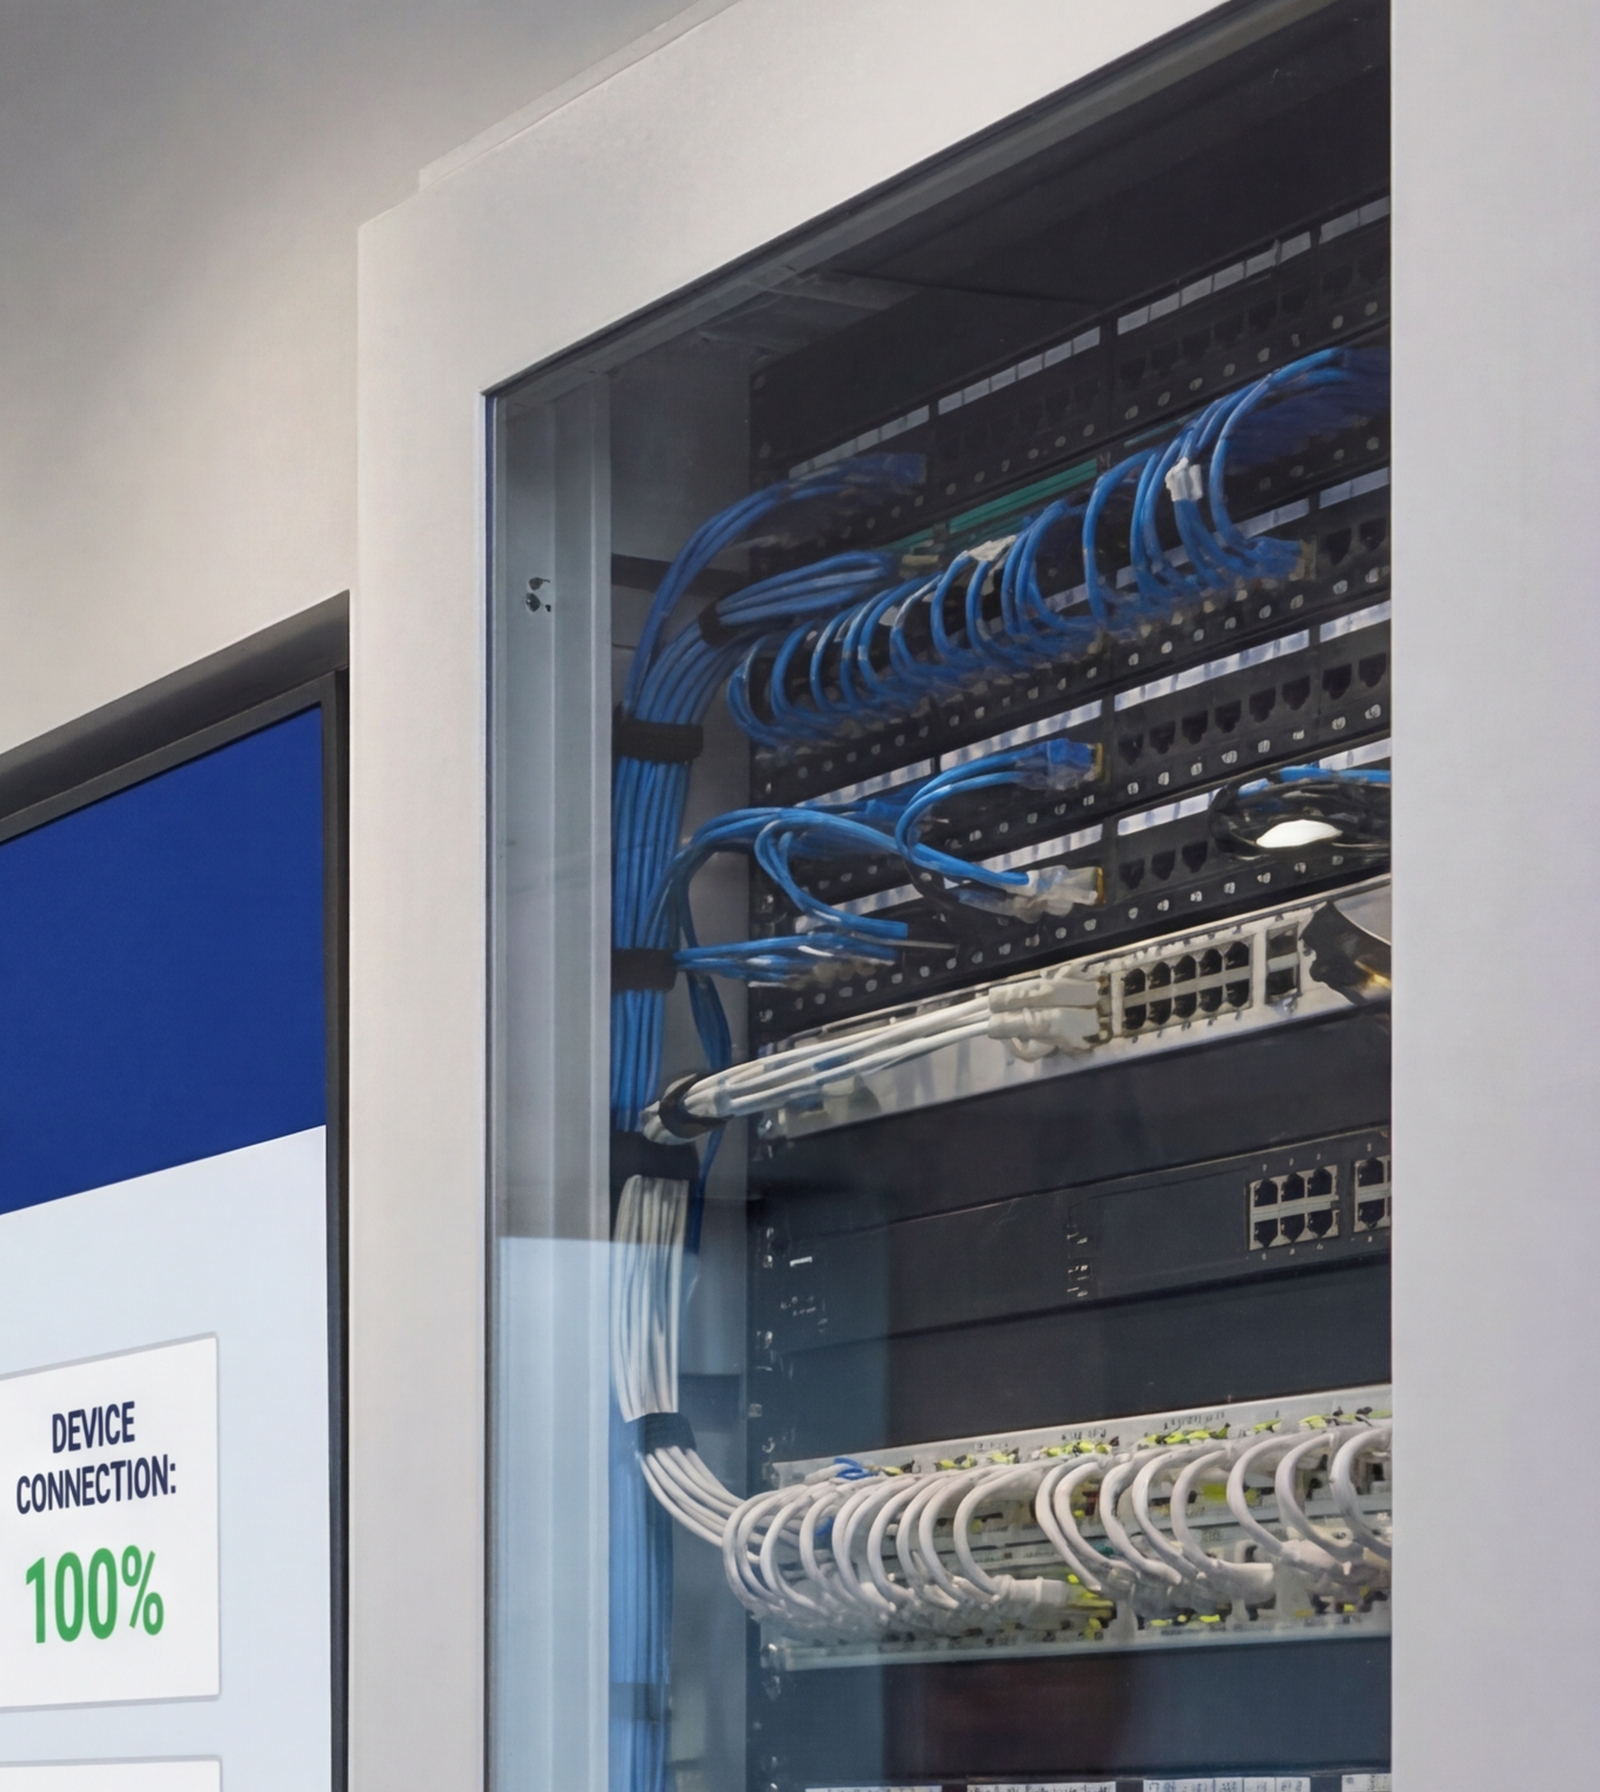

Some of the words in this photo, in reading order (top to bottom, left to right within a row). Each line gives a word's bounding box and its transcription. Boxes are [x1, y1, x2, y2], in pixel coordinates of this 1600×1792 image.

[53, 1401, 135, 1453] DEVICE
[17, 1454, 176, 1514] CONNECTION:
[26, 1545, 164, 1643] 100%
